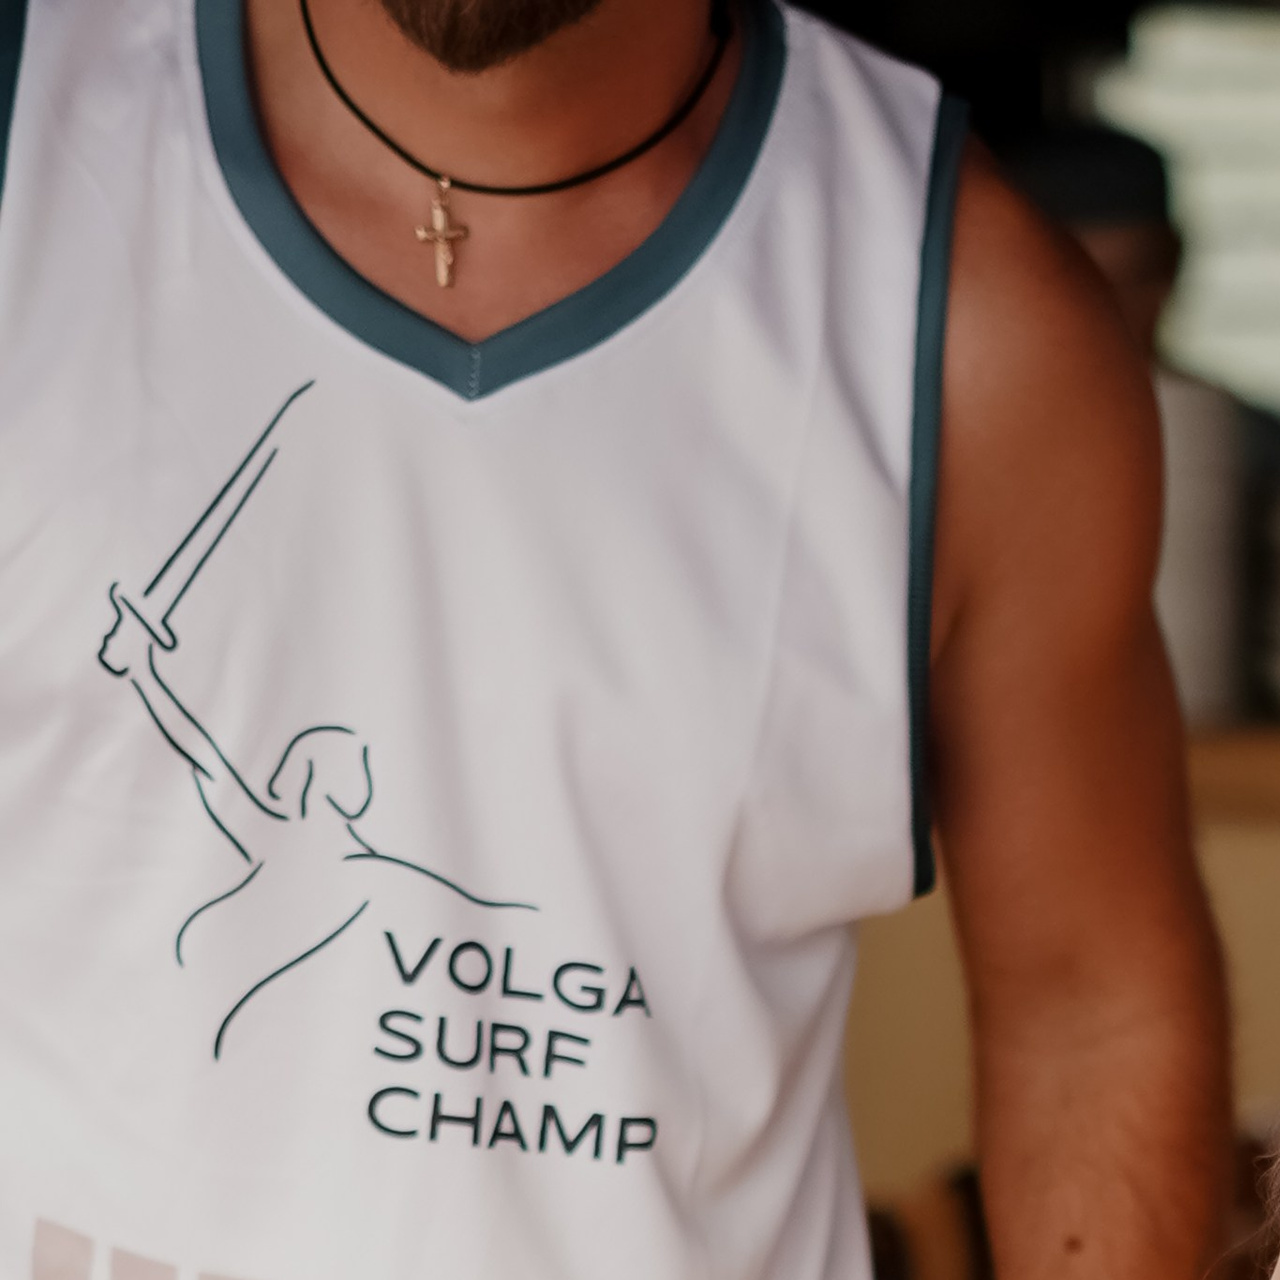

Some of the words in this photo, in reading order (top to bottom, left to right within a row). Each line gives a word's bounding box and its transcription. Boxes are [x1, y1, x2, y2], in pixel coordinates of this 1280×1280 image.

[384, 930, 653, 1019] VOLGA
[373, 1008, 592, 1078] SURF
[367, 1085, 658, 1165] CHAMP
